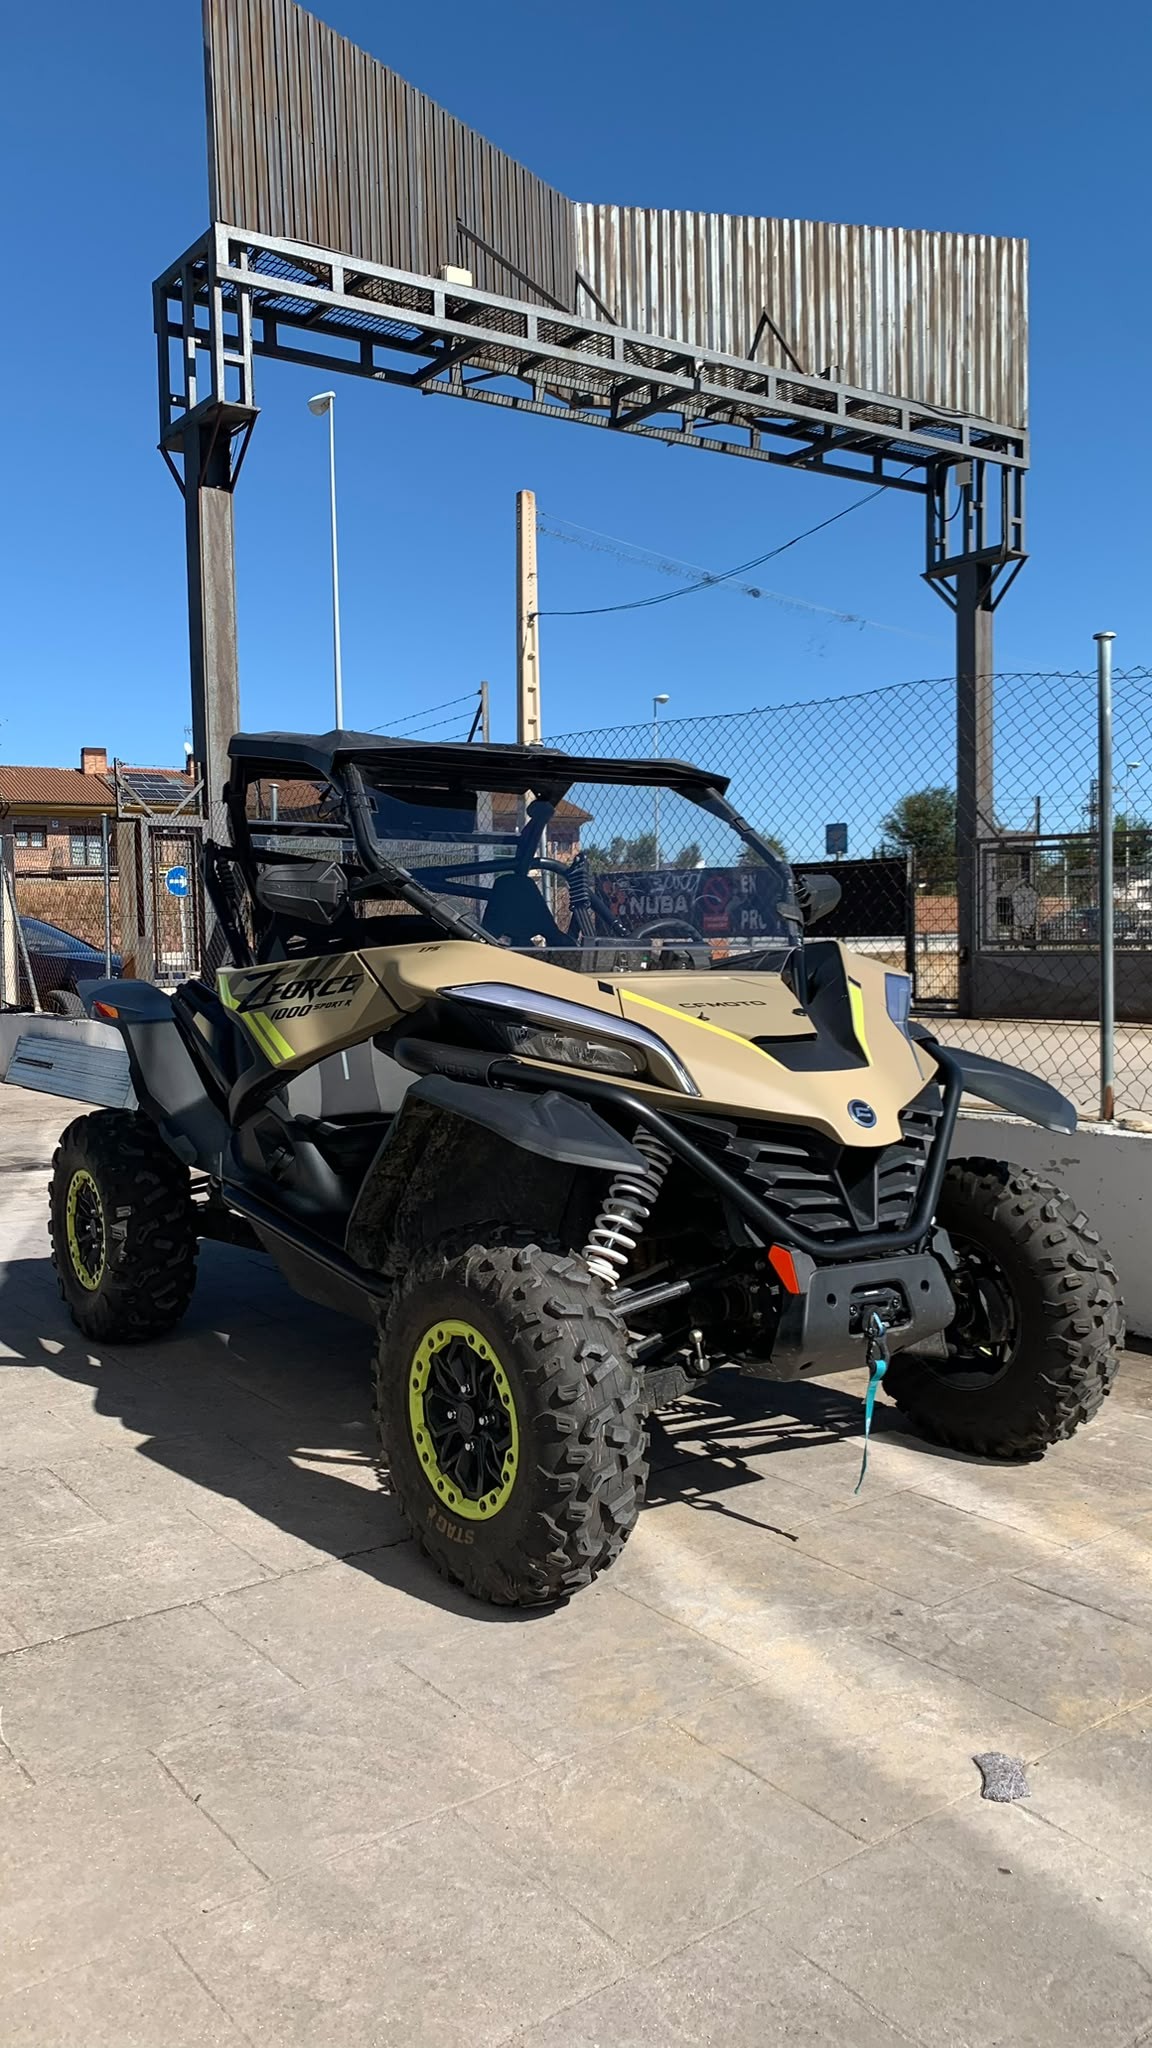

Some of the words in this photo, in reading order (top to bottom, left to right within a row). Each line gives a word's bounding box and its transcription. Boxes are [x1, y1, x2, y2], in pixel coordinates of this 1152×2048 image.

[629, 894, 689, 915] NUBA
[271, 1004, 312, 1020] 1000
[313, 1000, 344, 1010] SPORT
[679, 1000, 767, 1009] CFMOTO
